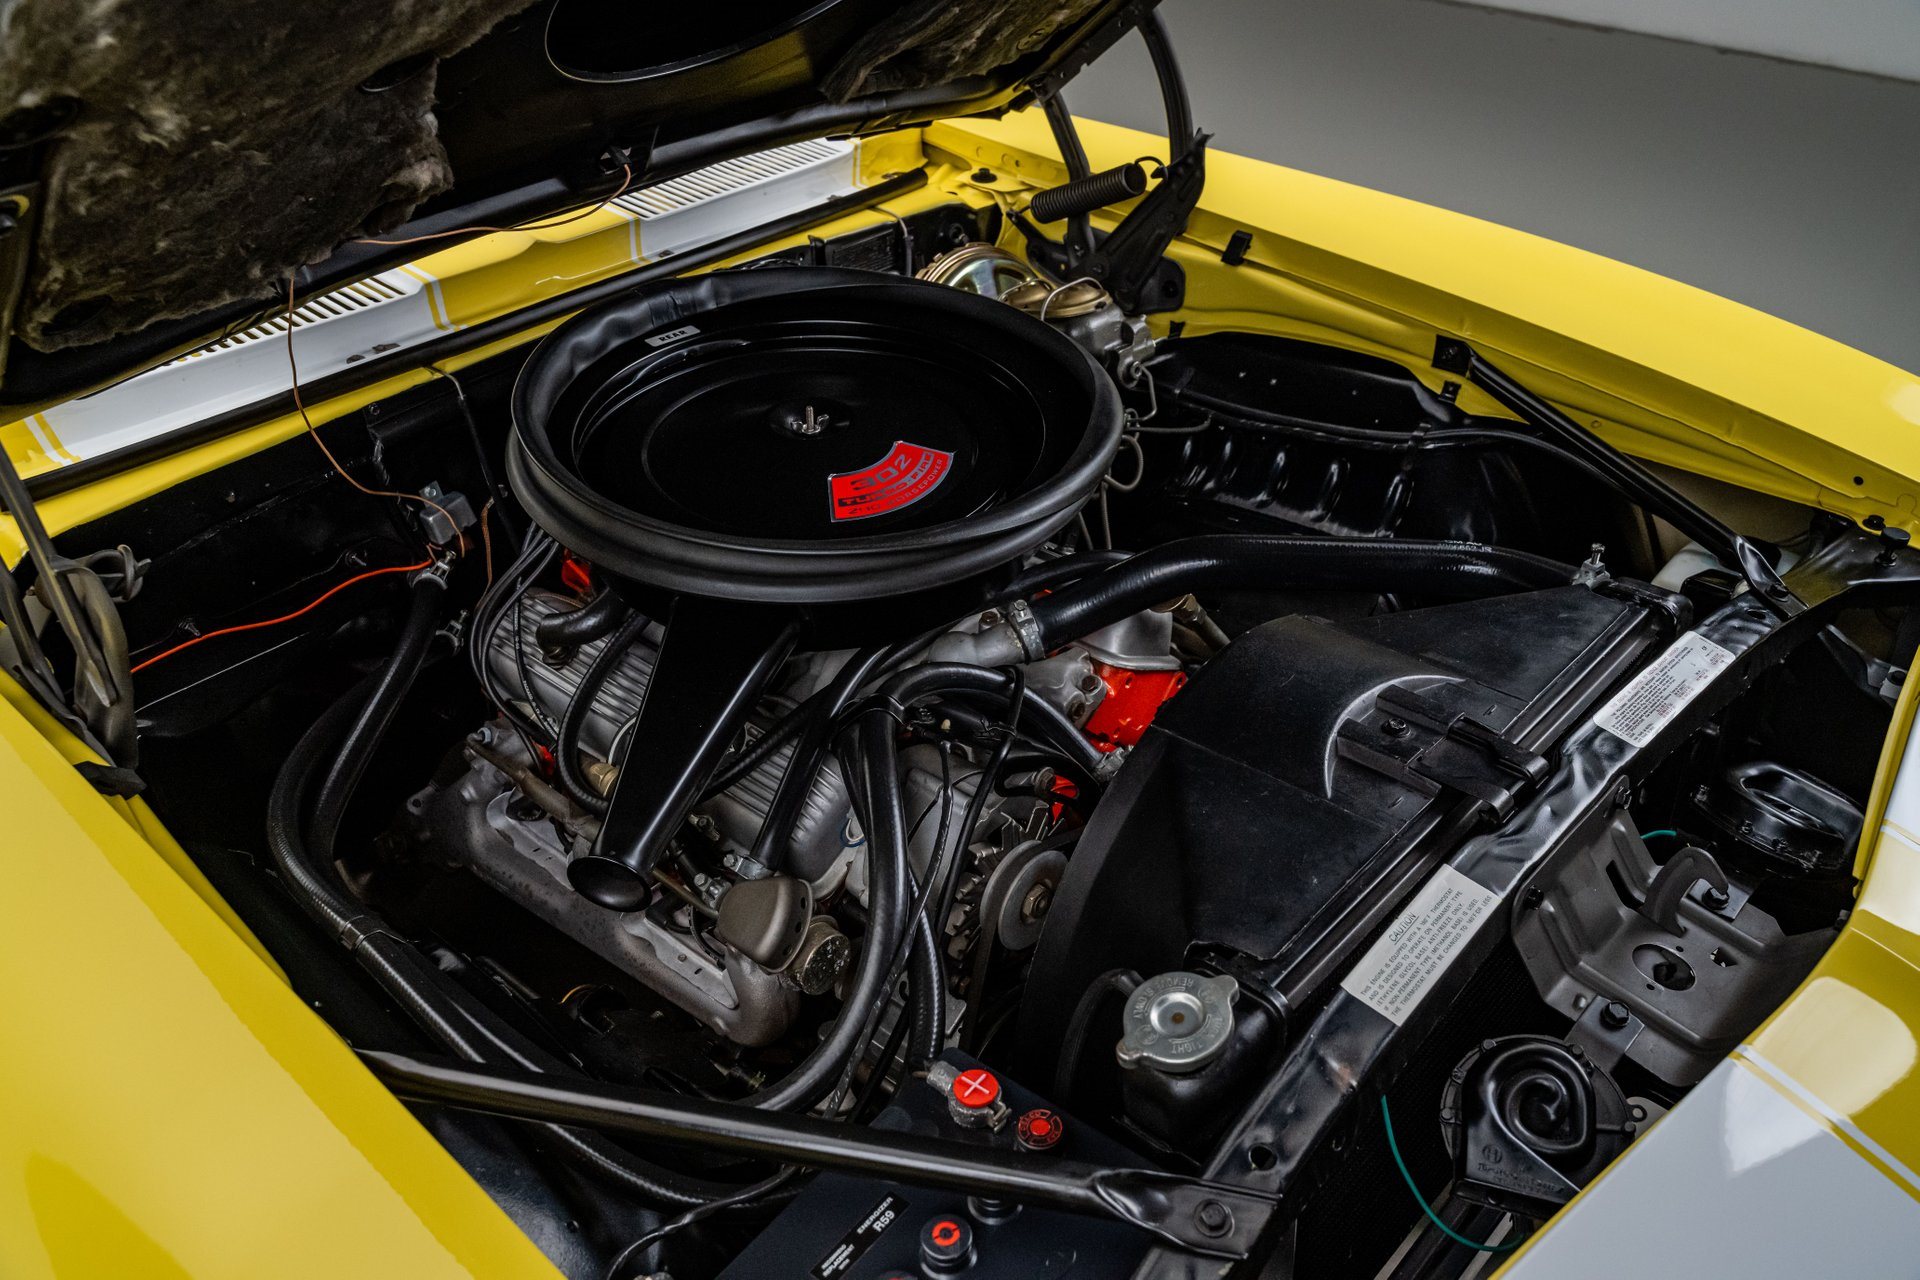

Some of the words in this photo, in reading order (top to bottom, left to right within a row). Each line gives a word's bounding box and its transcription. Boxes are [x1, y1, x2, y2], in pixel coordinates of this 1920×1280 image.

[659, 330, 687, 341] REAR
[850, 454, 911, 491] 302
[1360, 984, 1371, 996] THIS
[1369, 968, 1385, 985] ENGINE
[1388, 941, 1408, 963] EQUIPPED
[1405, 930, 1417, 943] WITH
[1430, 887, 1454, 913] THERMOSTAT
[1387, 911, 1416, 942] CAUTION
[1368, 989, 1379, 1001] AND
[1382, 961, 1403, 984] DESIGNED
[1401, 953, 1410, 961] TO
[1407, 934, 1426, 954] OPERATE
[1423, 926, 1432, 935] ON
[1430, 901, 1453, 927] PERMANENT
[1451, 890, 1462, 902] TYPE
[1391, 1005, 1401, 1017] THE
[1399, 975, 1426, 1006] THERMOSTAT
[1424, 960, 1438, 975] MUST
[1436, 953, 1444, 961] BE
[1442, 932, 1462, 954] CHANGED
[1459, 924, 1468, 932] TO
[1480, 894, 1492, 907] LESS
[1398, 959, 1416, 979] GLYCOL
[1426, 915, 1453, 945] ANTI-FREEZE
[1388, 966, 1422, 1006] NON-PERMANENT
[1419, 955, 1431, 967] TYPE
[1171, 1042, 1203, 1054] TIGHT
[857, 1197, 893, 1234] ENERGIZER
[872, 1210, 895, 1232] R59
